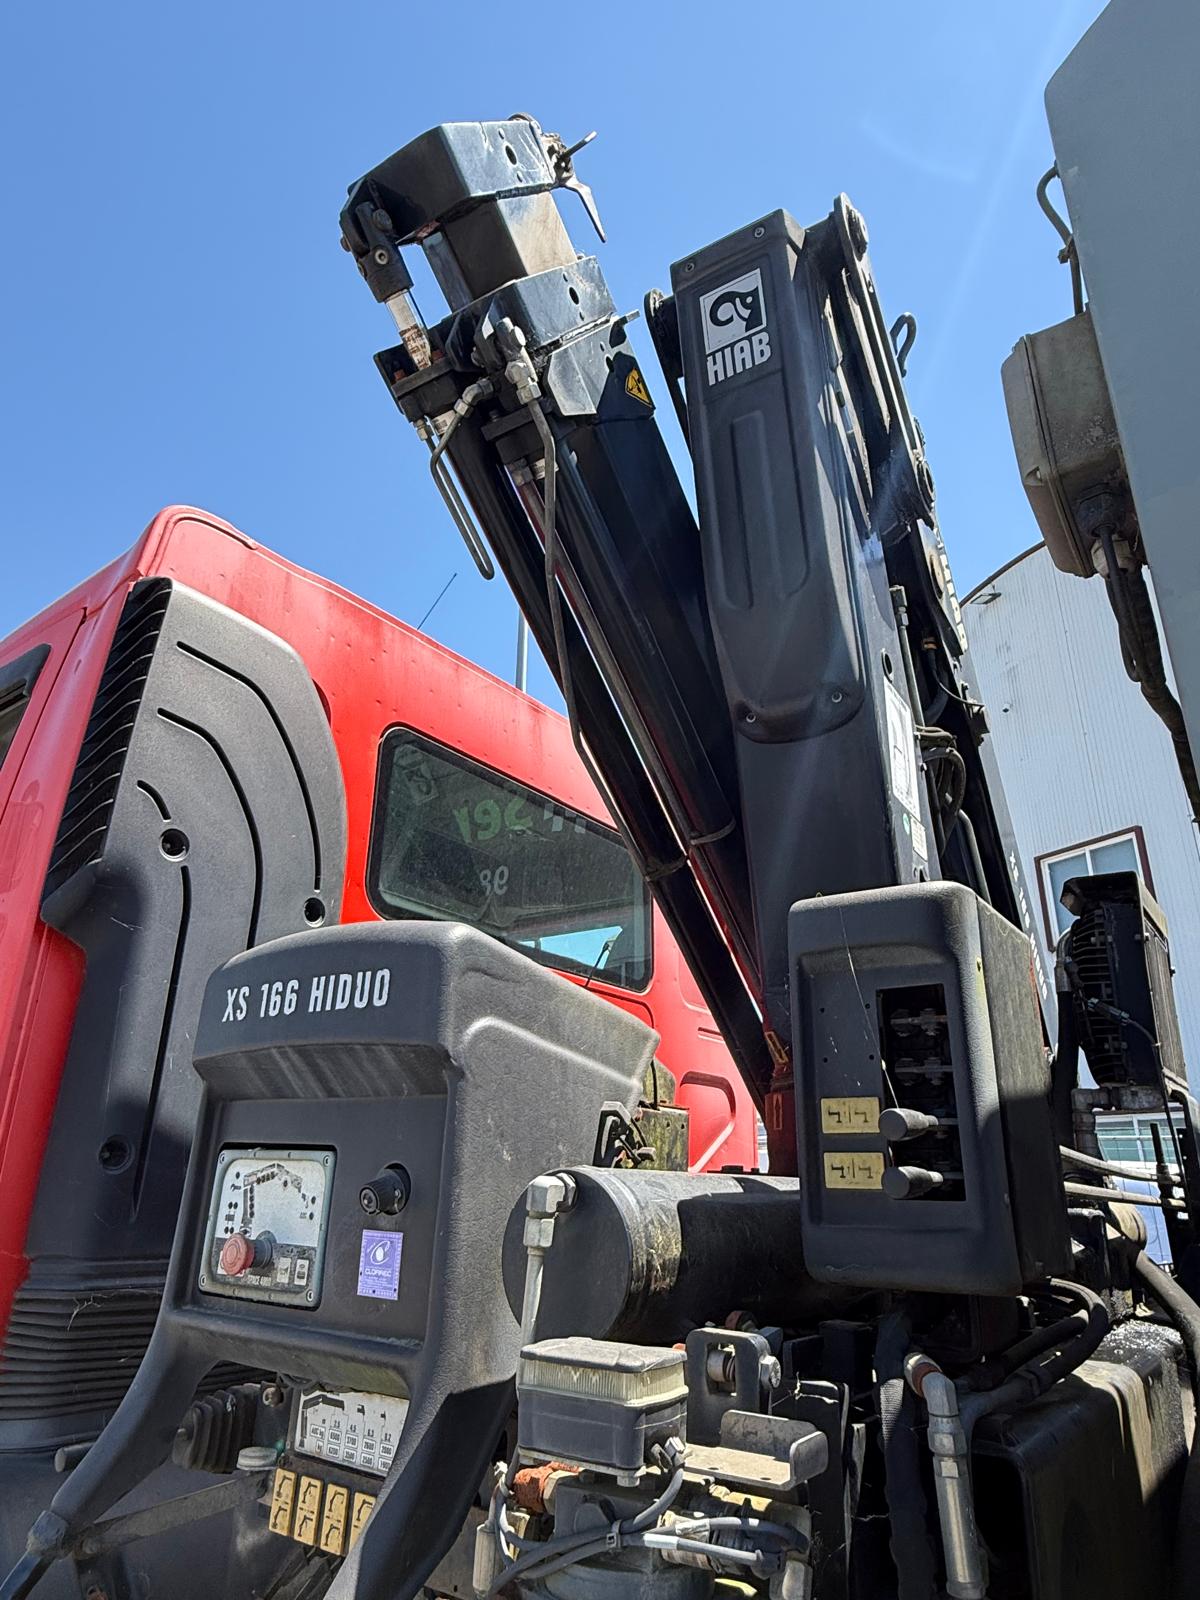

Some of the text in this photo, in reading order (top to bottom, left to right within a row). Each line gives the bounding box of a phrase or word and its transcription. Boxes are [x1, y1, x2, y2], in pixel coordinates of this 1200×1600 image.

[707, 331, 771, 386] HIAB
[222, 968, 391, 1022] XS 166 HIDUO
